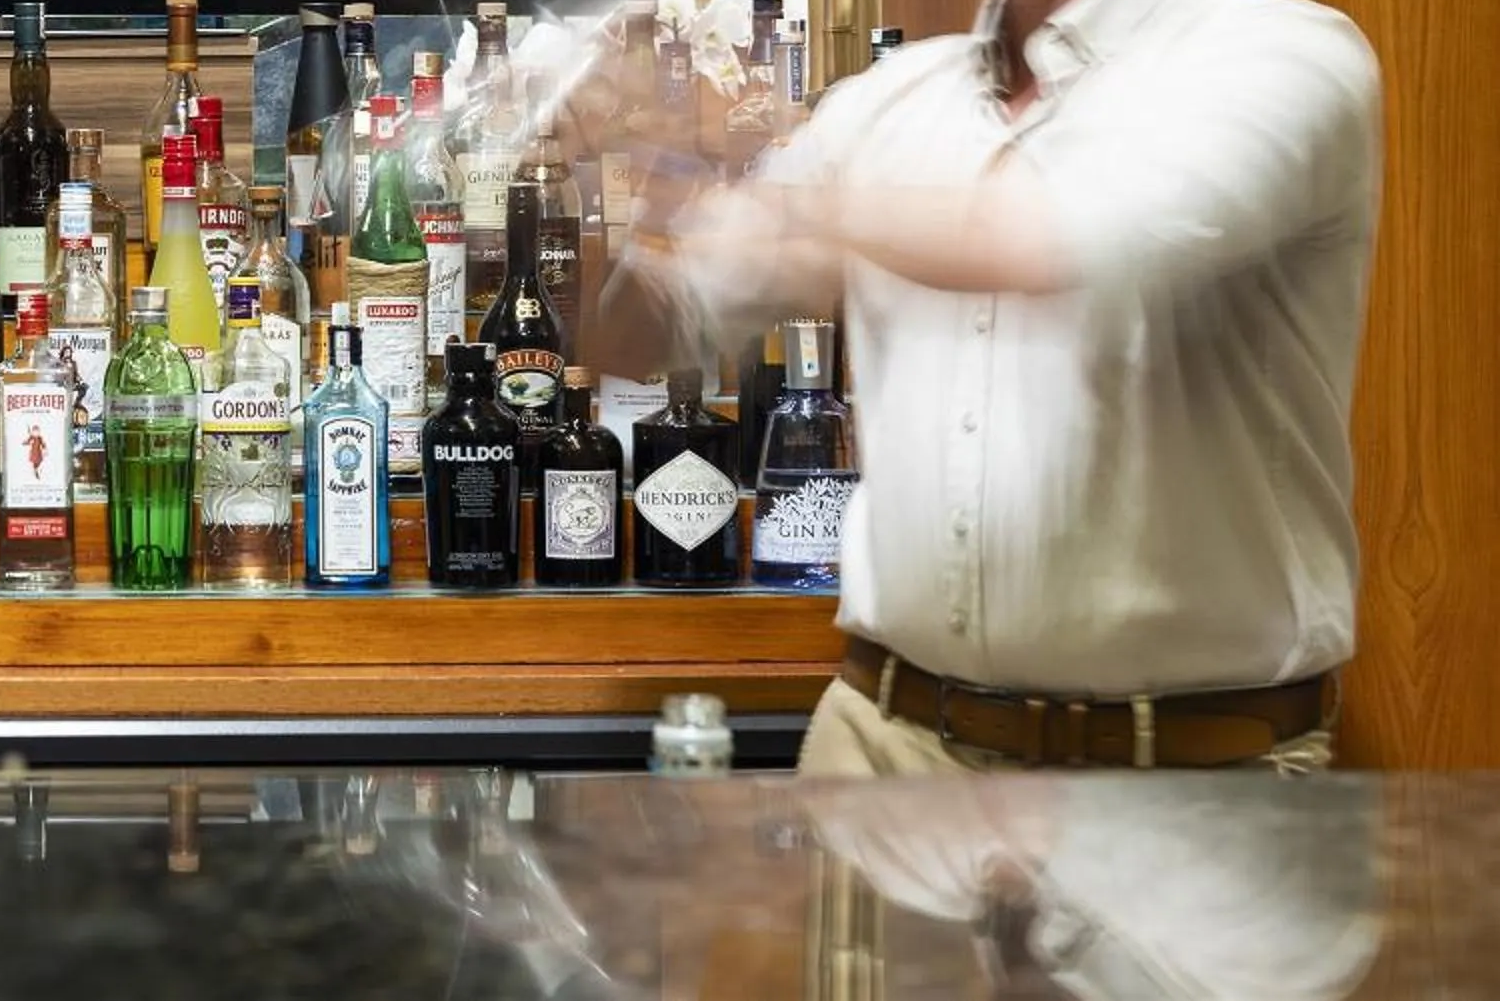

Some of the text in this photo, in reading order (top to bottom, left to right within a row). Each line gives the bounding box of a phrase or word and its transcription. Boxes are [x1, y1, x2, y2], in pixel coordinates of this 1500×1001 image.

[6, 394, 66, 412] BEEFEATER
[434, 445, 515, 461] BULLDOG
[779, 524, 815, 538] GIN
